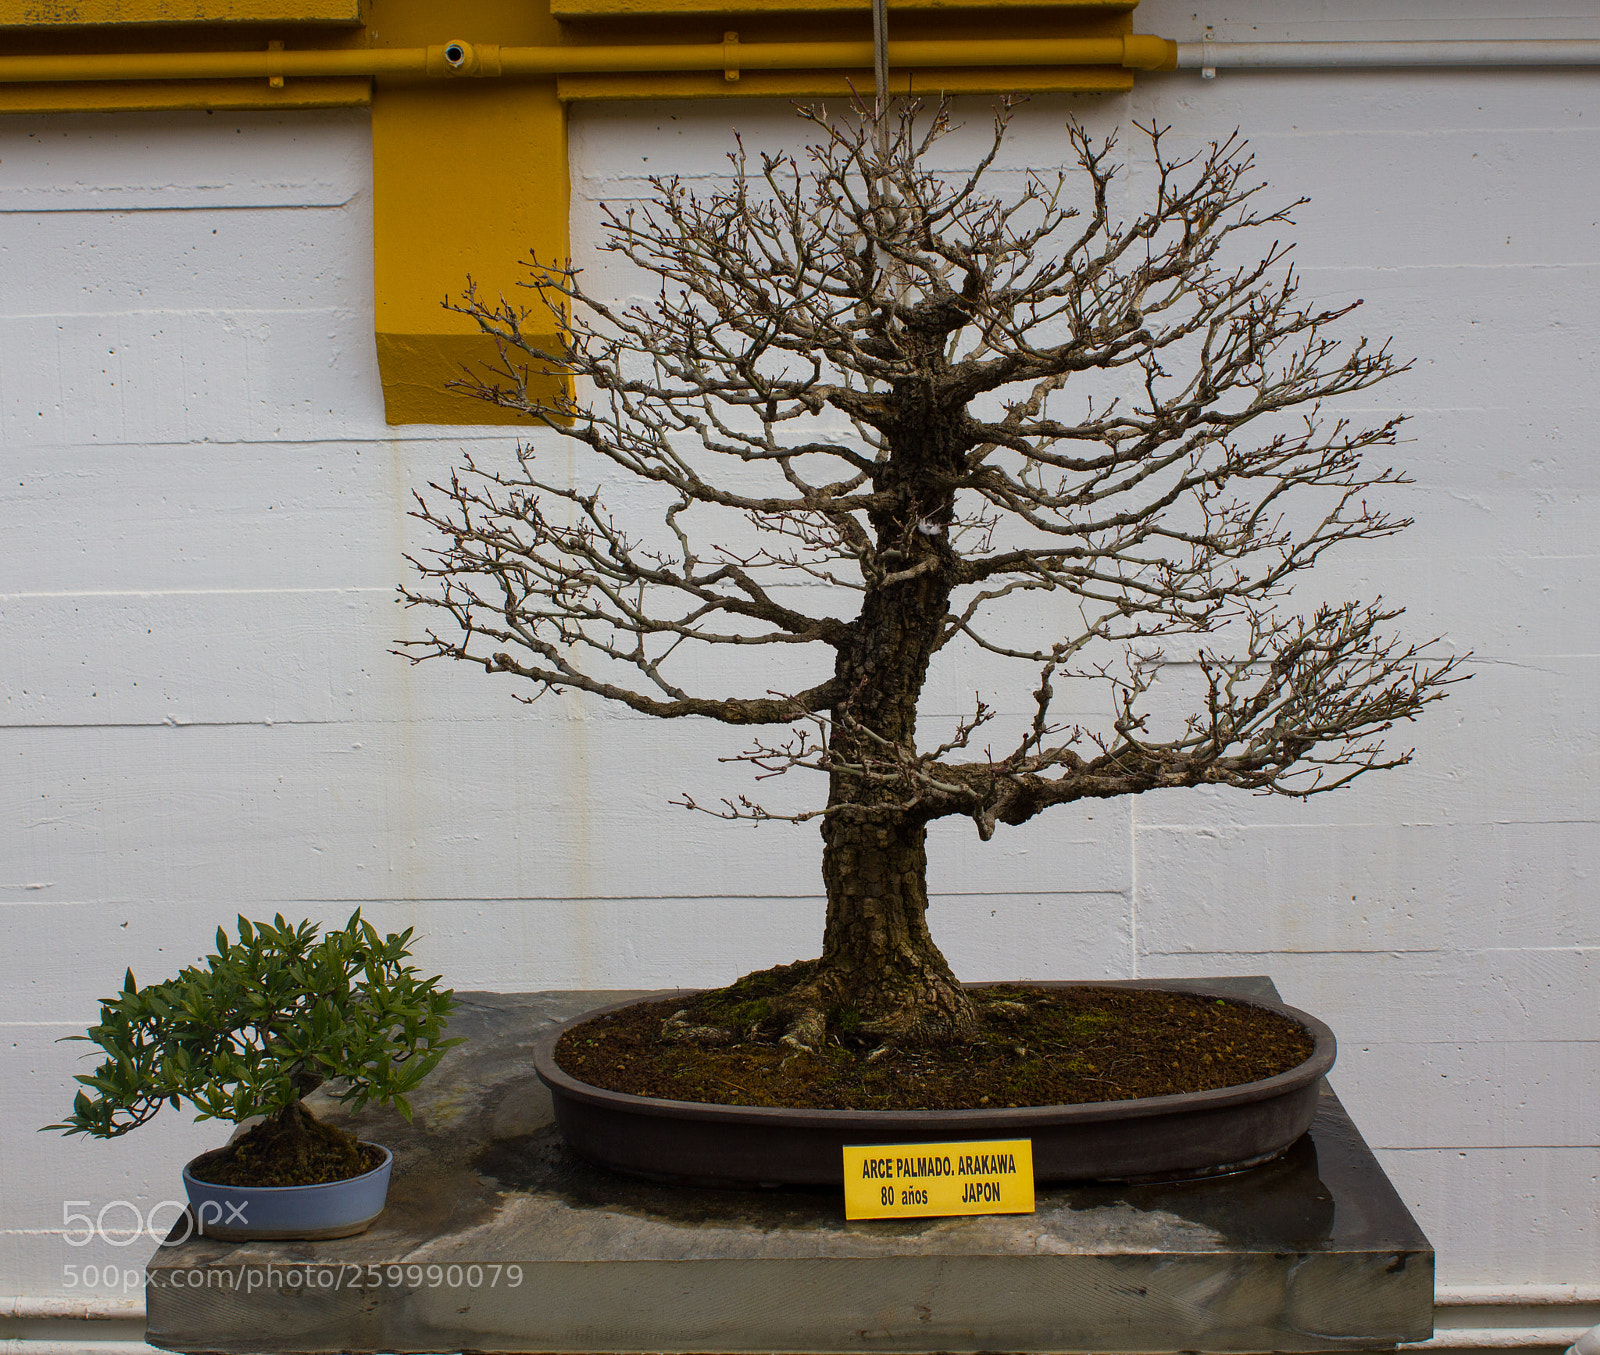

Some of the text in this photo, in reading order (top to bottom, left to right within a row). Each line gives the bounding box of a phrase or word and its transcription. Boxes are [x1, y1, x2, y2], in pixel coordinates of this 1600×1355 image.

[862, 1154, 1017, 1179] ARCE PALMADO. ARAKAWA
[881, 1182, 1001, 1206] 80 años JAPON
